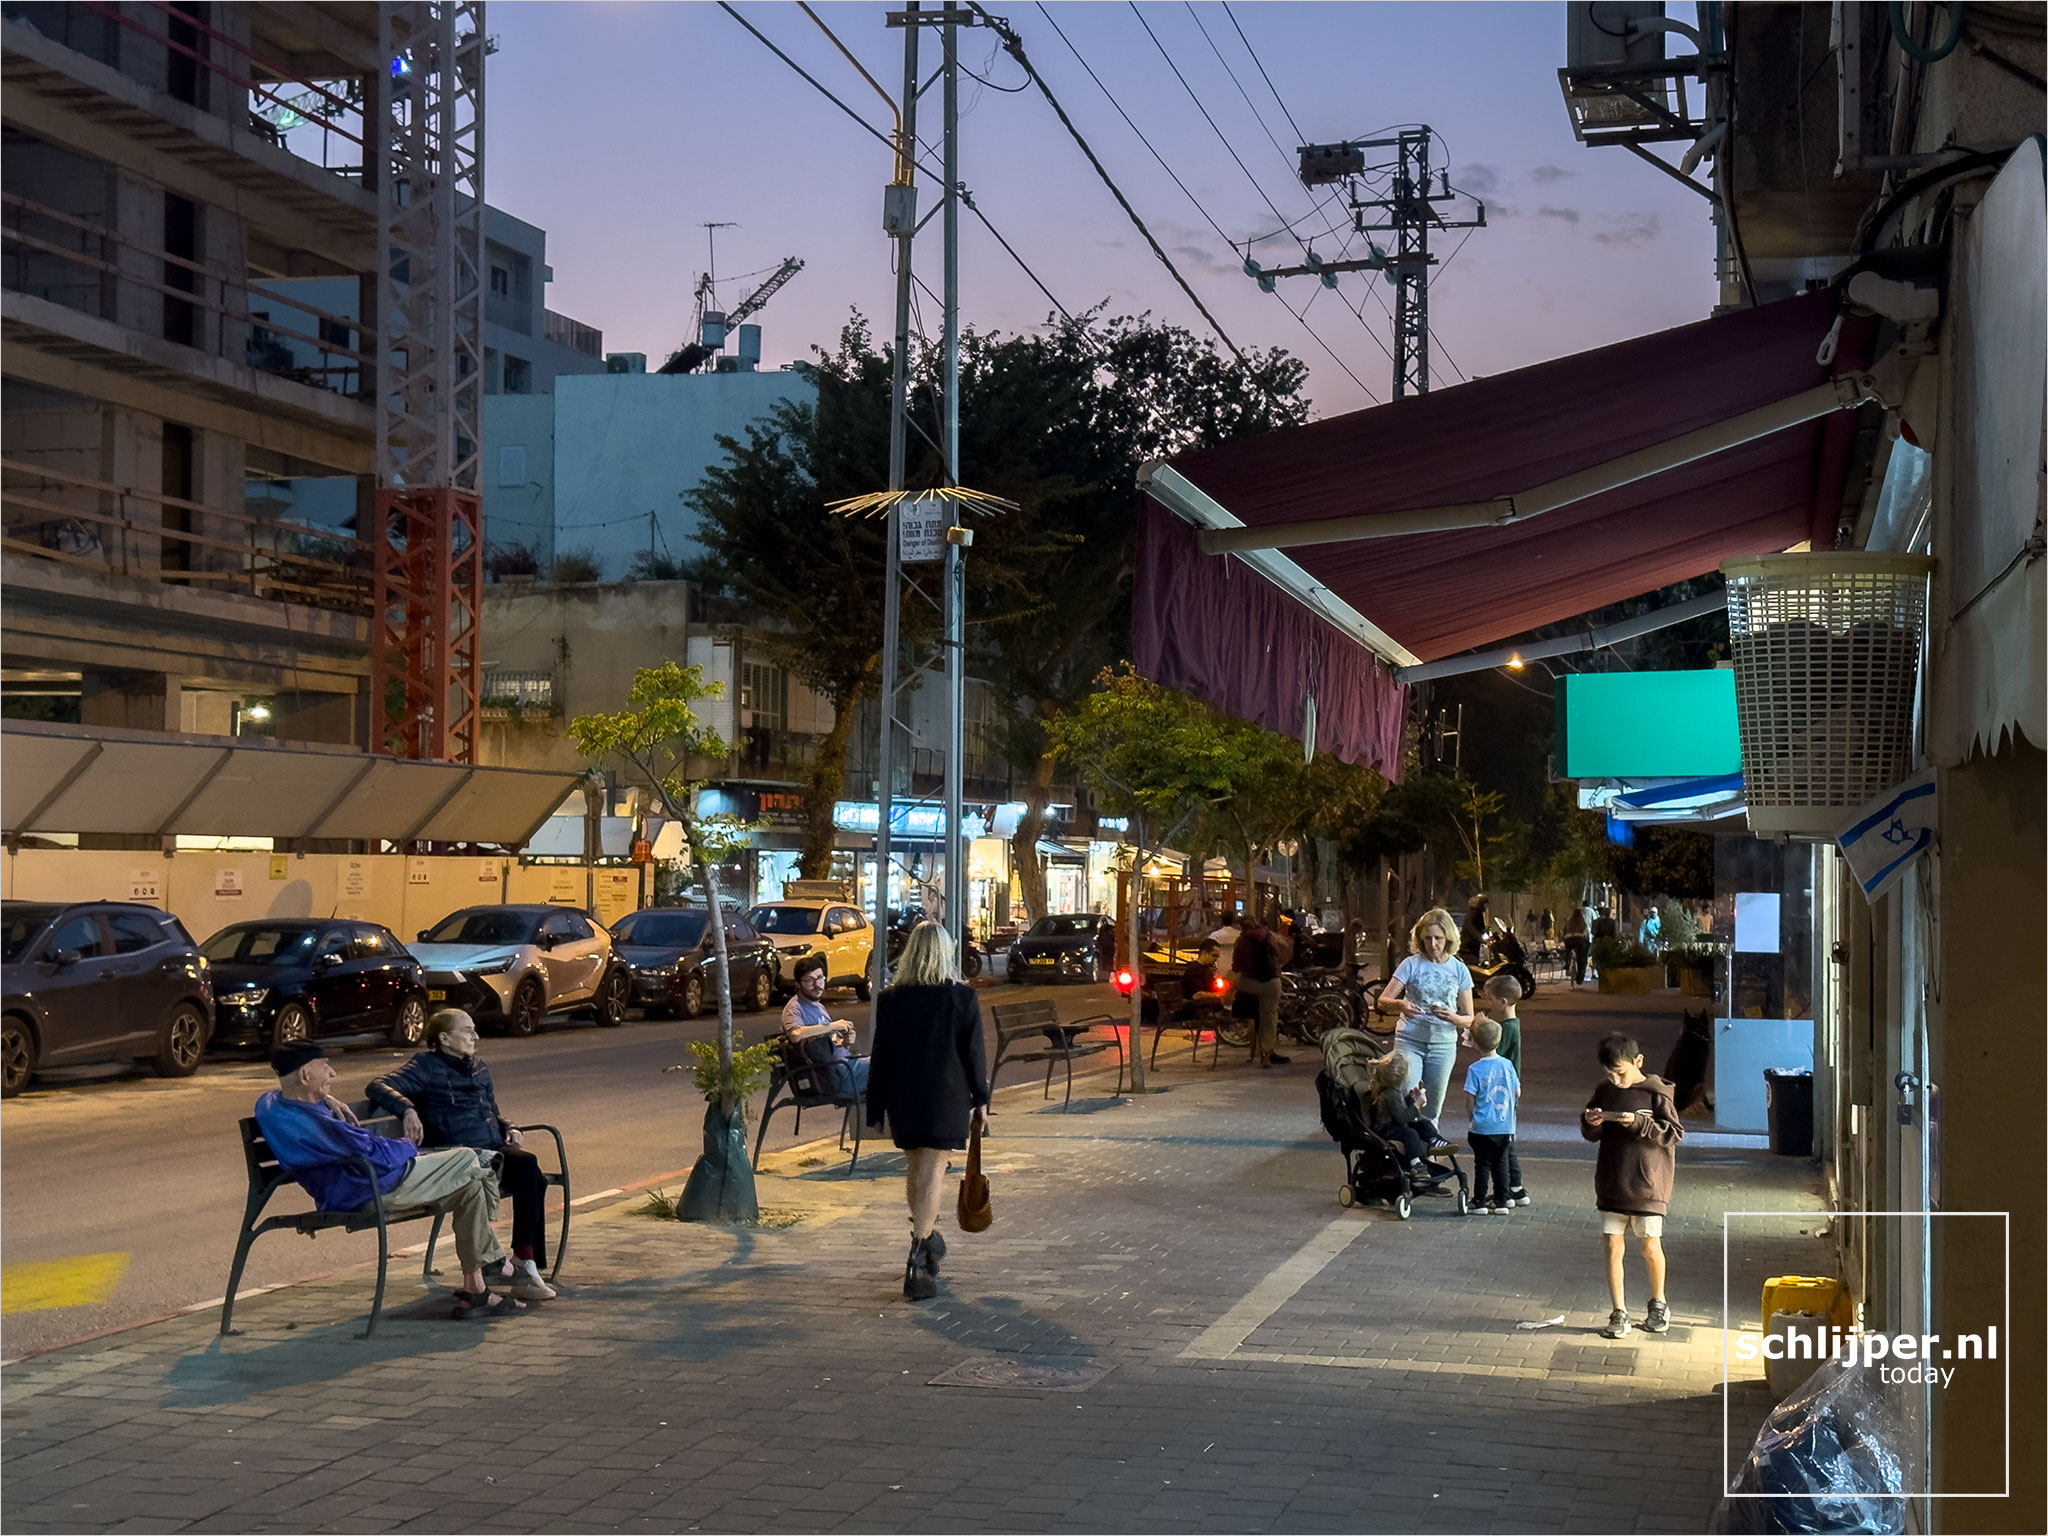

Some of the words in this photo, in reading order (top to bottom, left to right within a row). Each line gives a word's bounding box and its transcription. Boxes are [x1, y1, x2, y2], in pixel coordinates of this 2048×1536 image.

[925, 520, 942, 529] מתח
[924, 529, 943, 537] סכנת
[903, 540, 920, 548] Danger
[1488, 1085, 1509, 1122] 9
